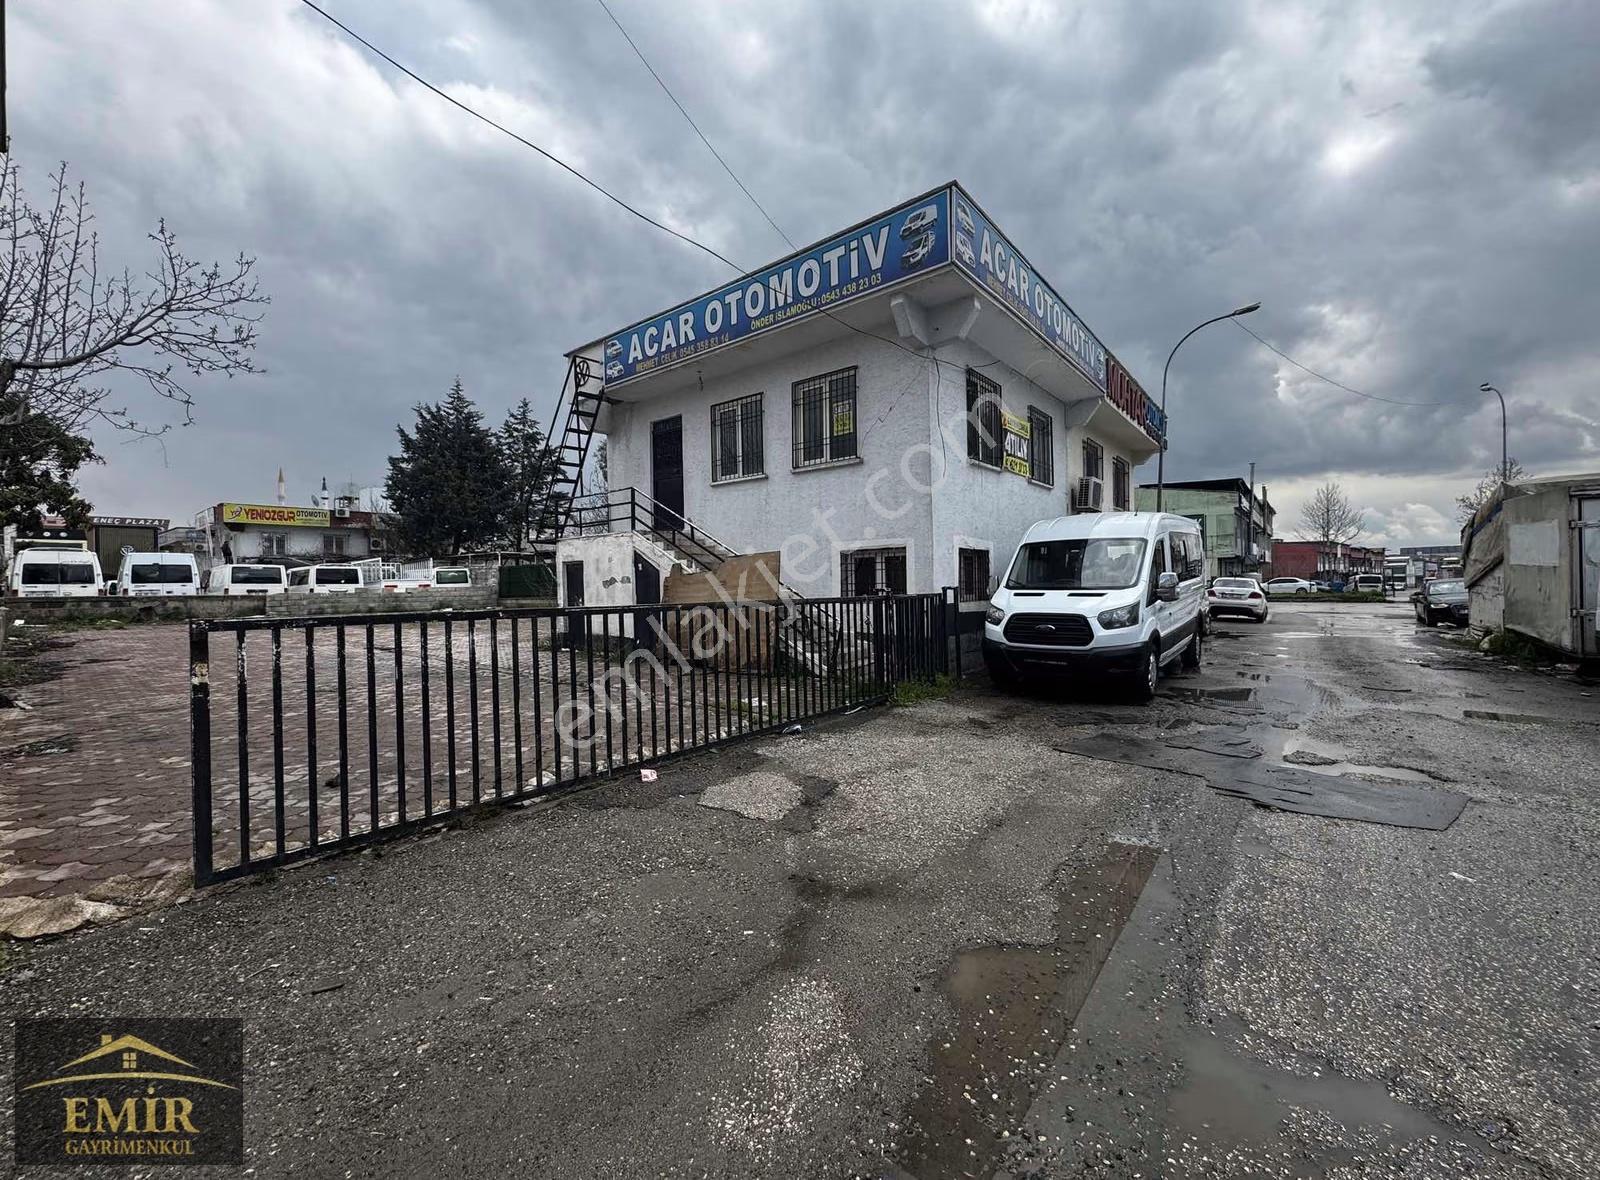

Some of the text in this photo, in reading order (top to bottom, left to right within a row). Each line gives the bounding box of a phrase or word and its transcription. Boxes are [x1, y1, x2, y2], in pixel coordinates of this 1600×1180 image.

[842, 281, 857, 297] 438
[859, 278, 869, 290] 23
[870, 272, 882, 286] 03
[980, 227, 1030, 306] ACAR
[628, 311, 696, 364] ACAR
